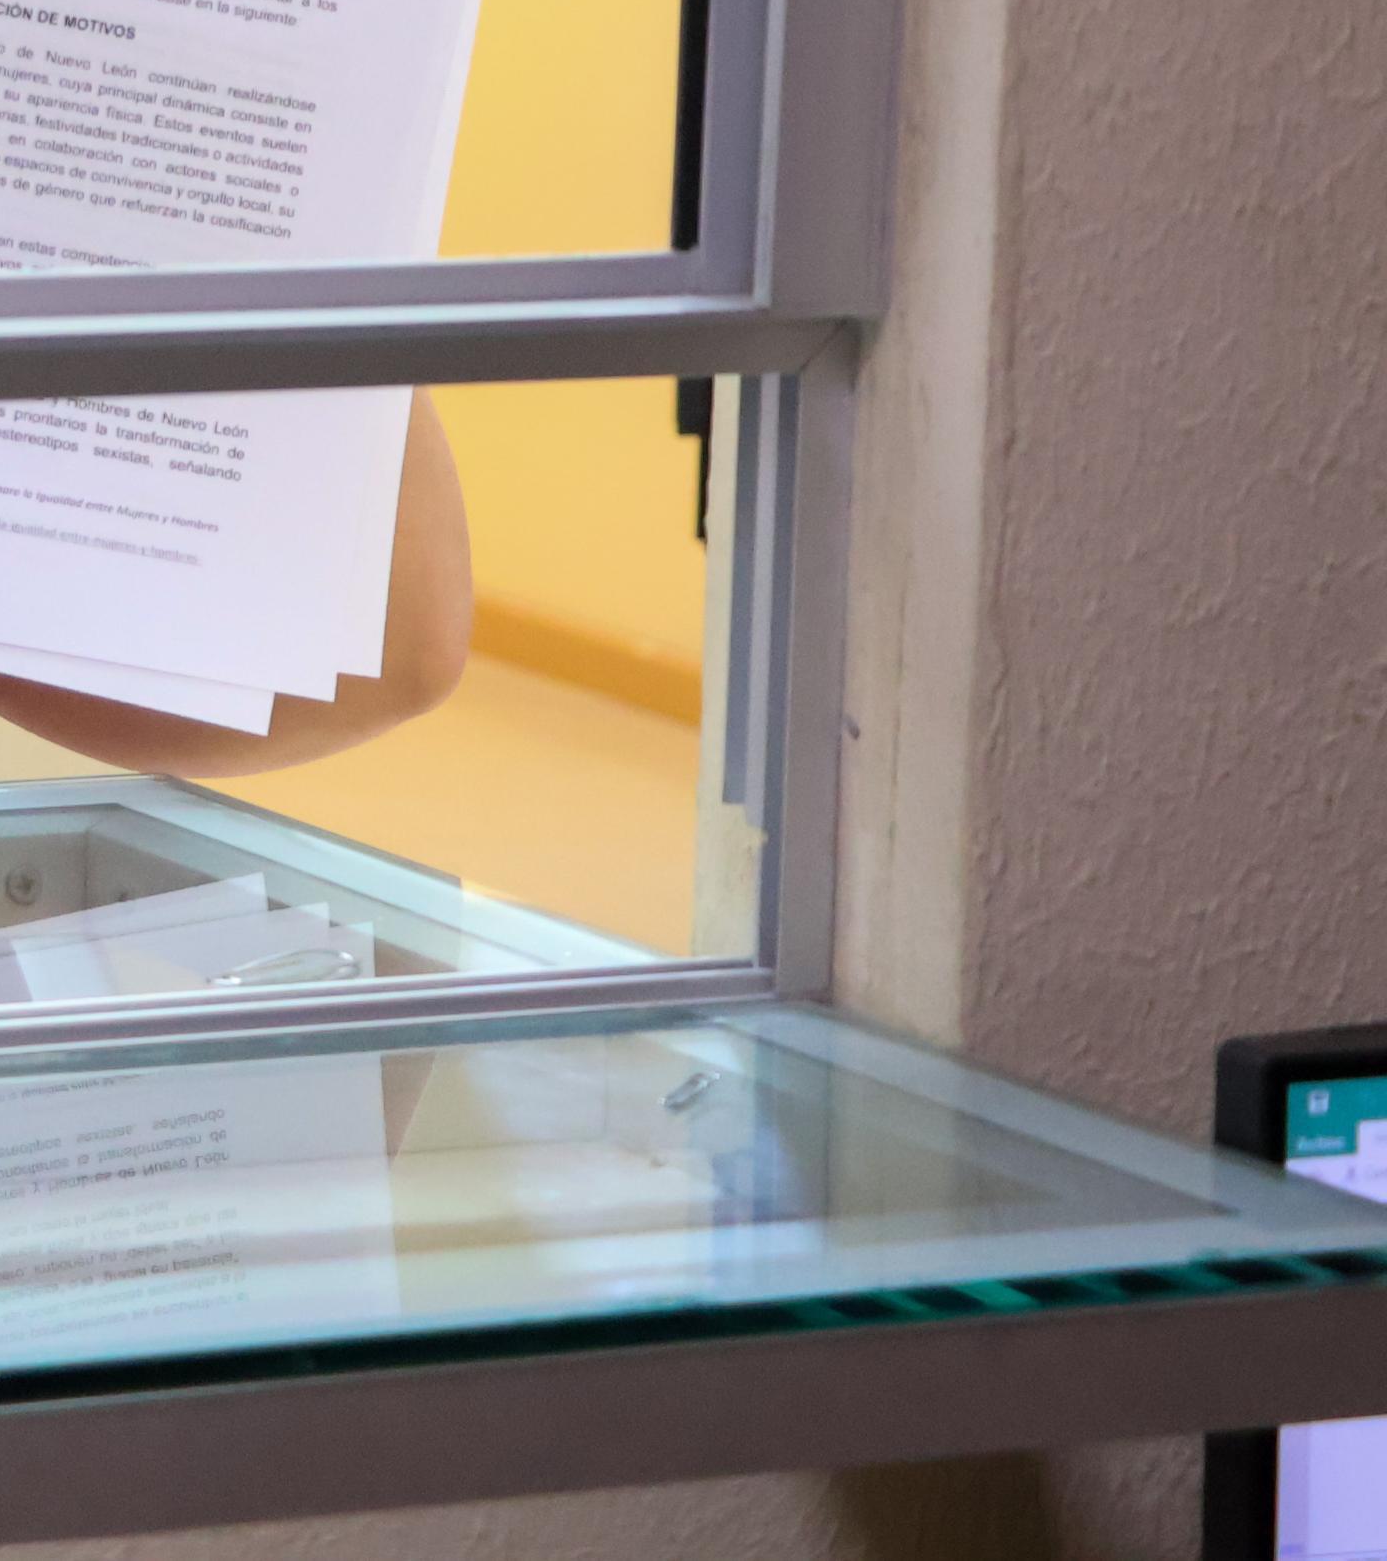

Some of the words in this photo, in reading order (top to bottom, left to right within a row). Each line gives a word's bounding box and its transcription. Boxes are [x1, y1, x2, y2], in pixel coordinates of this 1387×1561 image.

[36, 9, 59, 26] DE
[63, 14, 136, 40] MOTIVOS
[15, 45, 34, 60] de
[44, 49, 91, 70] Nuevo
[3, 88, 20, 102] su
[26, 93, 99, 116] apariencia
[152, 112, 193, 133] Estos
[198, 125, 255, 145] eventos
[260, 136, 307, 154] suelen
[34, 113, 117, 141] festividades
[120, 130, 209, 158] tradicionales
[224, 151, 303, 176] actividades
[7, 133, 26, 146] en
[131, 155, 157, 171] con
[164, 162, 216, 182] actores
[224, 173, 282, 194] sociales
[12, 409, 88, 432] prioritarios
[94, 421, 108, 436] la
[225, 445, 245, 461] de
[135, 407, 154, 422] de
[160, 410, 207, 432] Nuevo
